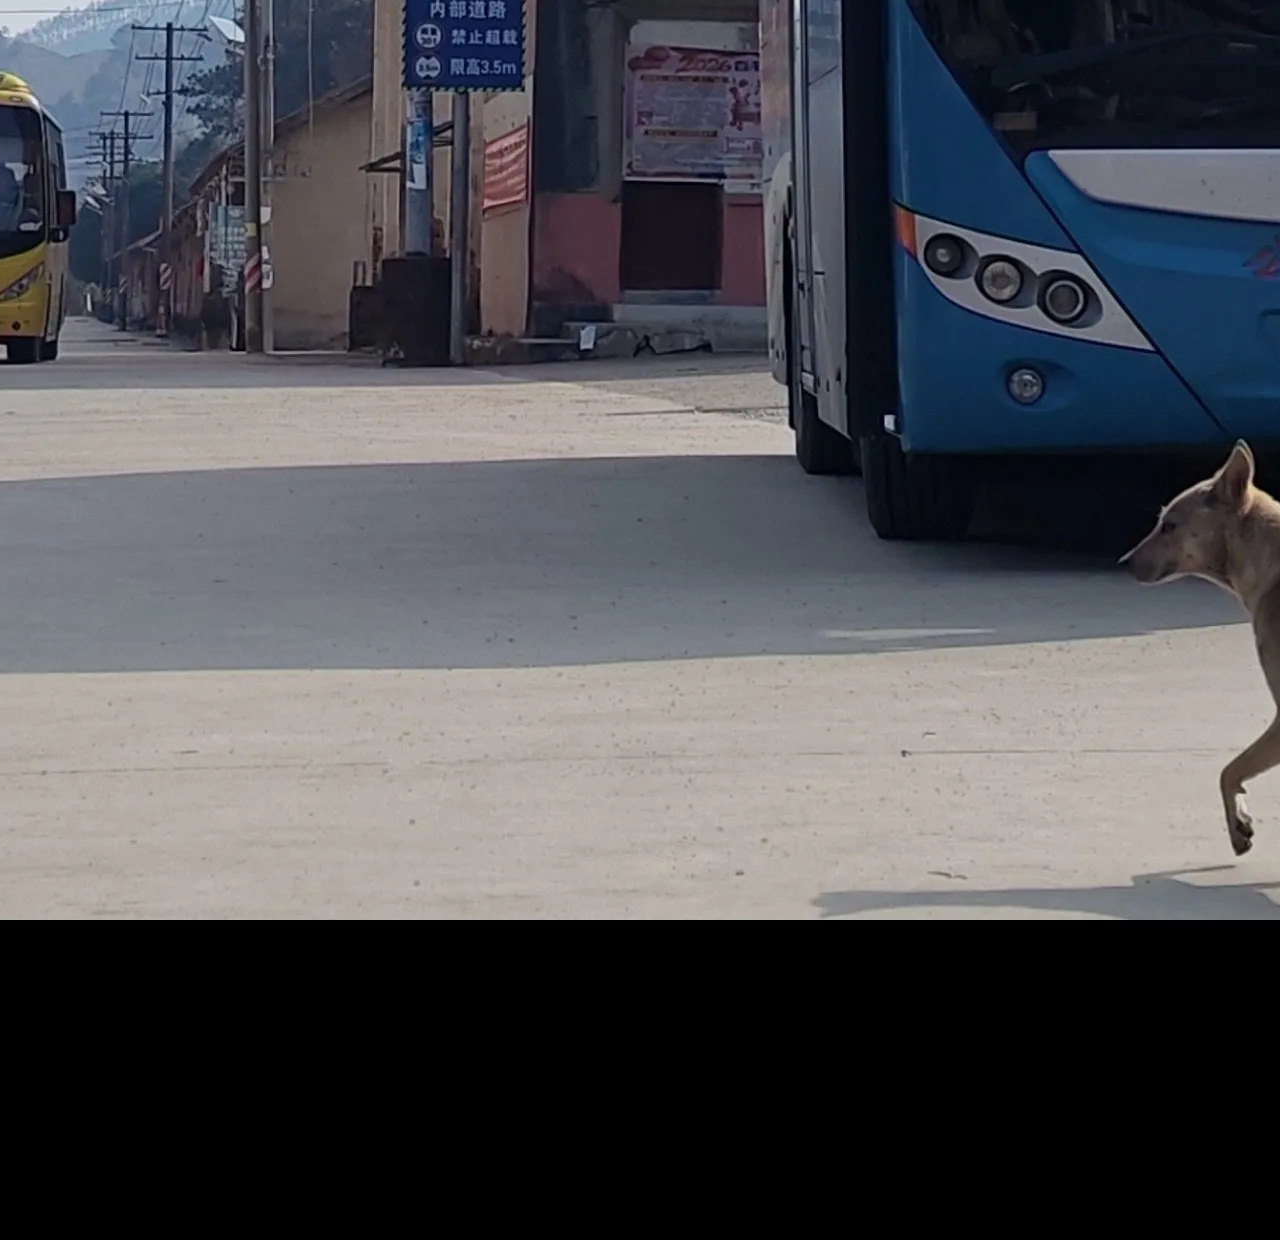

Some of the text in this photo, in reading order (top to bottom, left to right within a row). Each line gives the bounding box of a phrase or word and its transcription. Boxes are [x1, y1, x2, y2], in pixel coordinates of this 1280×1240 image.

[429, 0, 507, 19] 内部道路
[451, 28, 518, 45] 禁止超载
[450, 58, 517, 76] 限高3.5m
[675, 55, 732, 74] 2026
